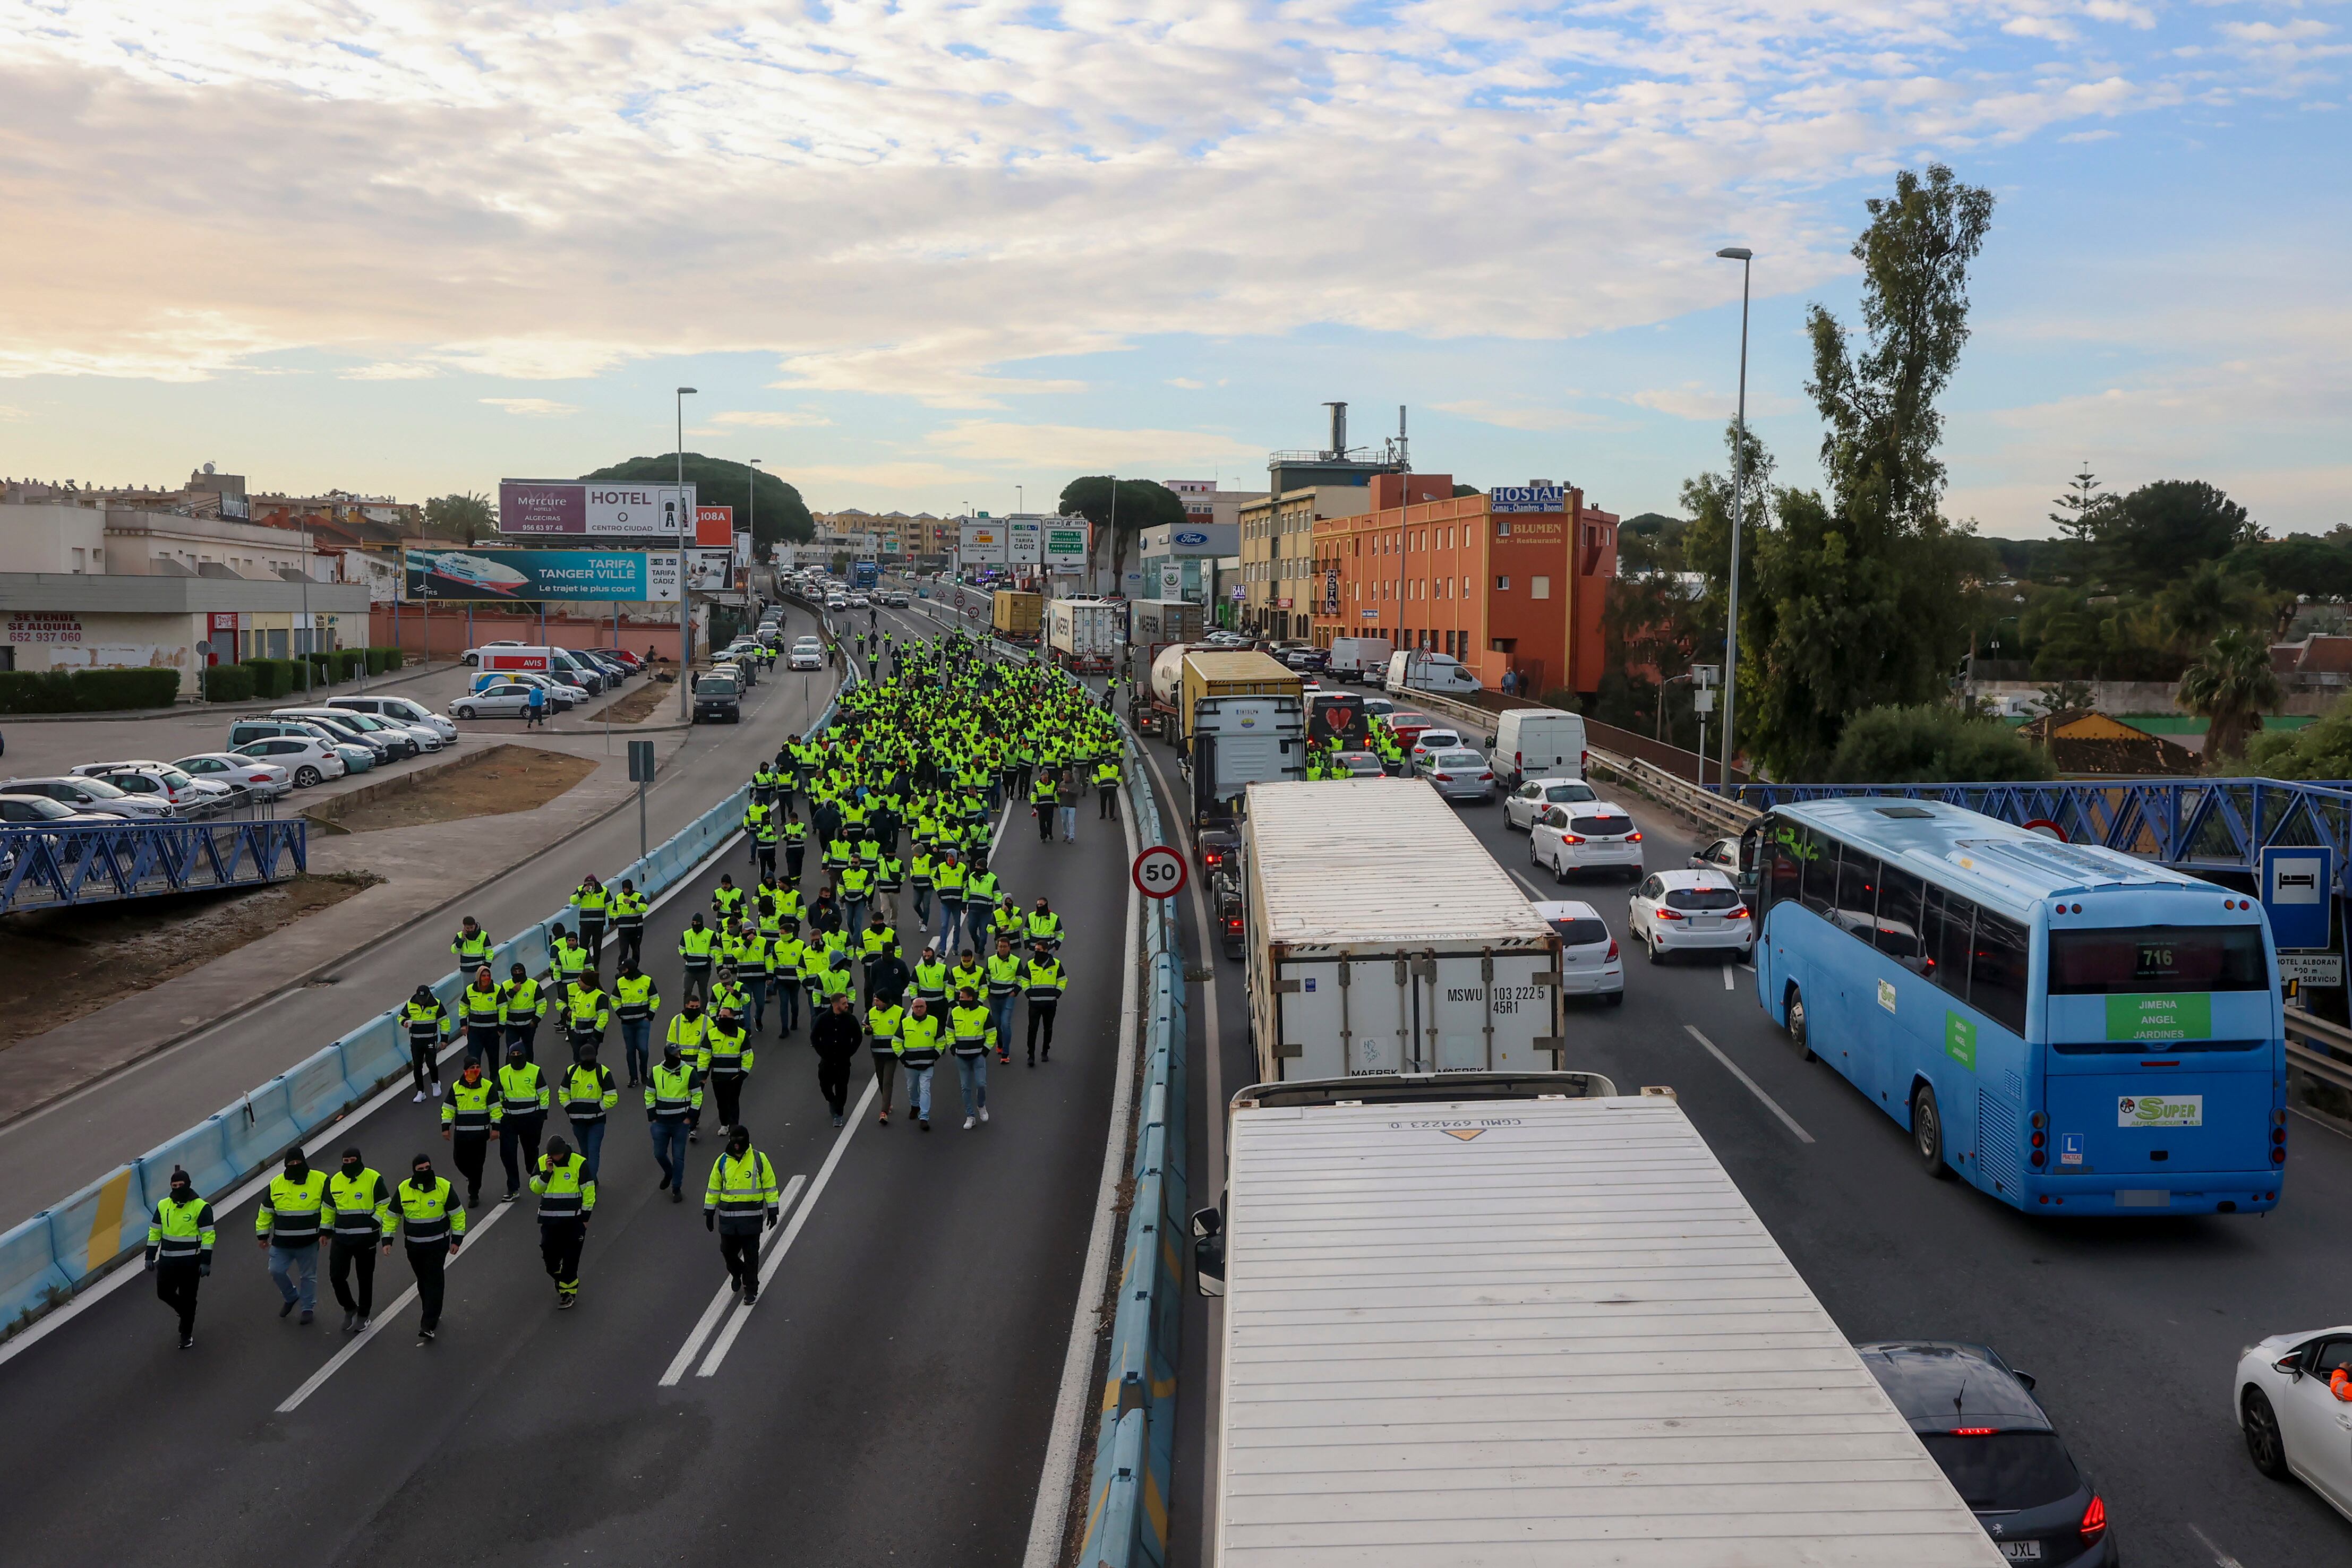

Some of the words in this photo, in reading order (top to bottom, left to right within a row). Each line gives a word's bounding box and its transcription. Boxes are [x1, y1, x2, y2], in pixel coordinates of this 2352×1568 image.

[592, 491, 652, 505] HOTEL
[1492, 487, 1562, 501] HOSTAL
[518, 497, 567, 506] Mercure
[1492, 503, 1509, 512] Camas
[1513, 503, 1540, 512] Chambres
[1544, 503, 1562, 512] Rooms
[1513, 524, 1561, 534] BLUMEN
[1181, 533, 1201, 543] Ford
[588, 559, 636, 569] TARIFA
[538, 569, 594, 579] TANGER
[597, 570, 635, 579] VILLE
[1233, 585, 1245, 595] BAR
[9, 632, 31, 642] 652
[36, 632, 56, 642] 937
[61, 632, 81, 642] 060
[1145, 863, 1175, 881] 50
[2143, 950, 2173, 965] 716
[1448, 988, 1482, 1002] MSWU
[1494, 987, 1512, 1000] 103
[1516, 987, 1535, 1000] 222
[1538, 986, 1544, 999] 5
[1493, 1001, 1518, 1014] 45R1
[2139, 1000, 2177, 1009] JIMENA
[2133, 1030, 2184, 1039] JARDINES
[1410, 1119, 1472, 1128] 694223
[2067, 1137, 2077, 1151] L
[2010, 1542, 2035, 1557] JXL
